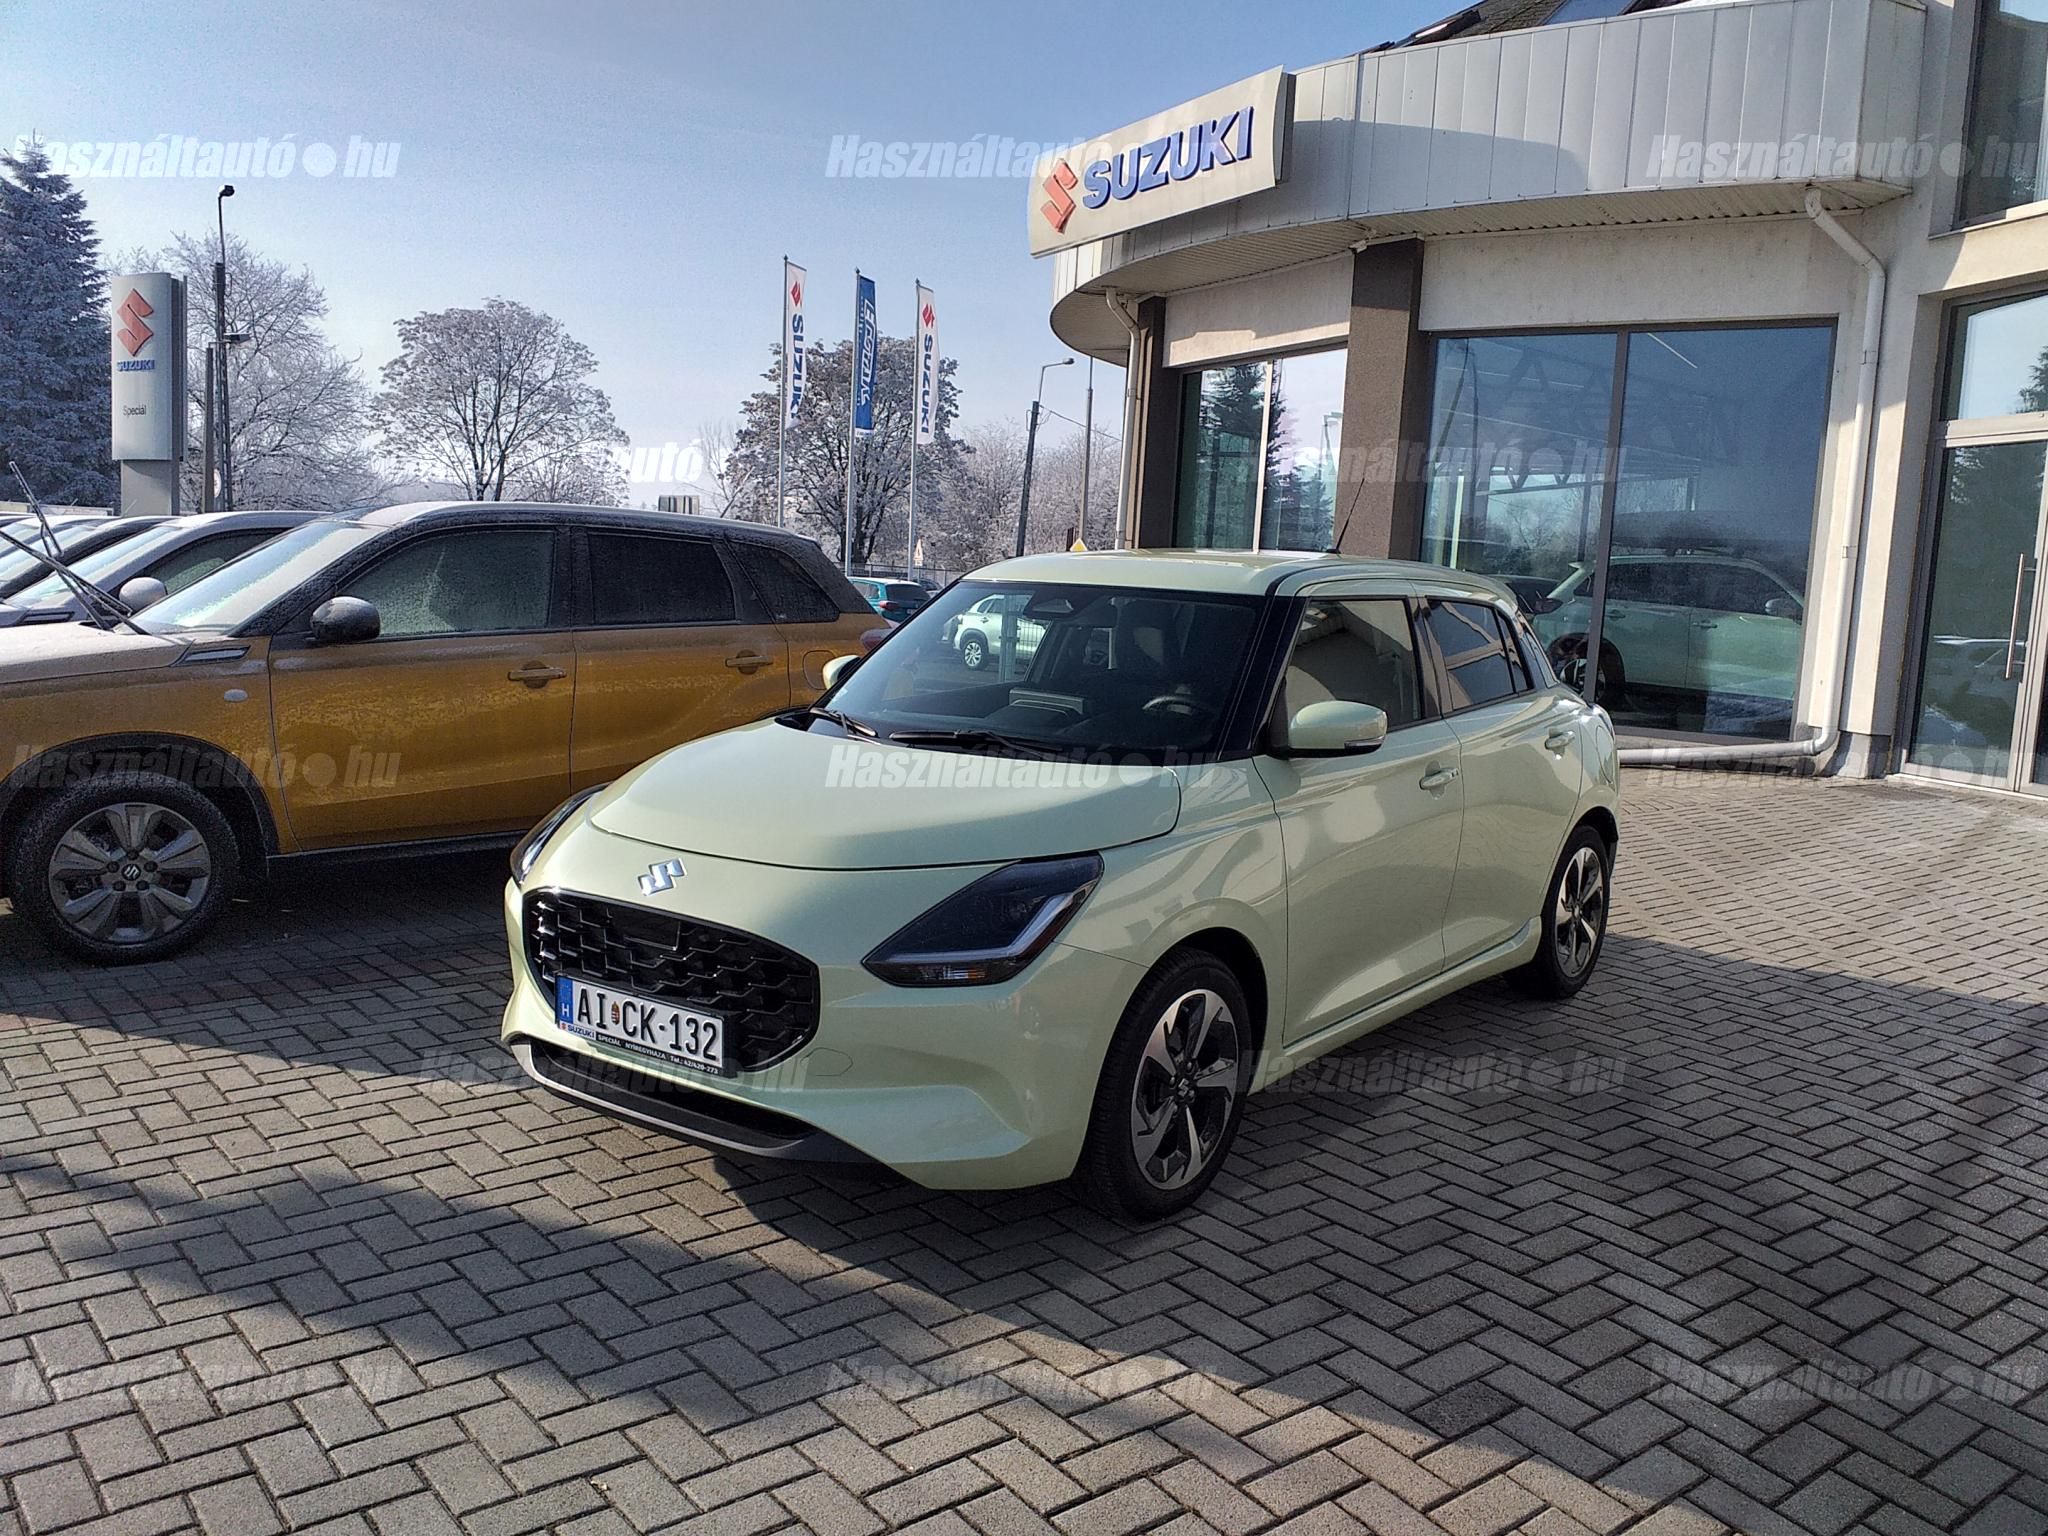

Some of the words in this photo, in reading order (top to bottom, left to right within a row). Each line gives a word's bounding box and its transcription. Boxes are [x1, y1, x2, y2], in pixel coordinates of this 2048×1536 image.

[1082, 105, 1254, 209] SUZUKI
[117, 360, 156, 372] SUZUKI
[790, 313, 804, 419] SUZUKI
[920, 333, 933, 434] SUZUKI
[561, 1003, 570, 1018] H
[567, 1024, 595, 1039] SUZUKI
